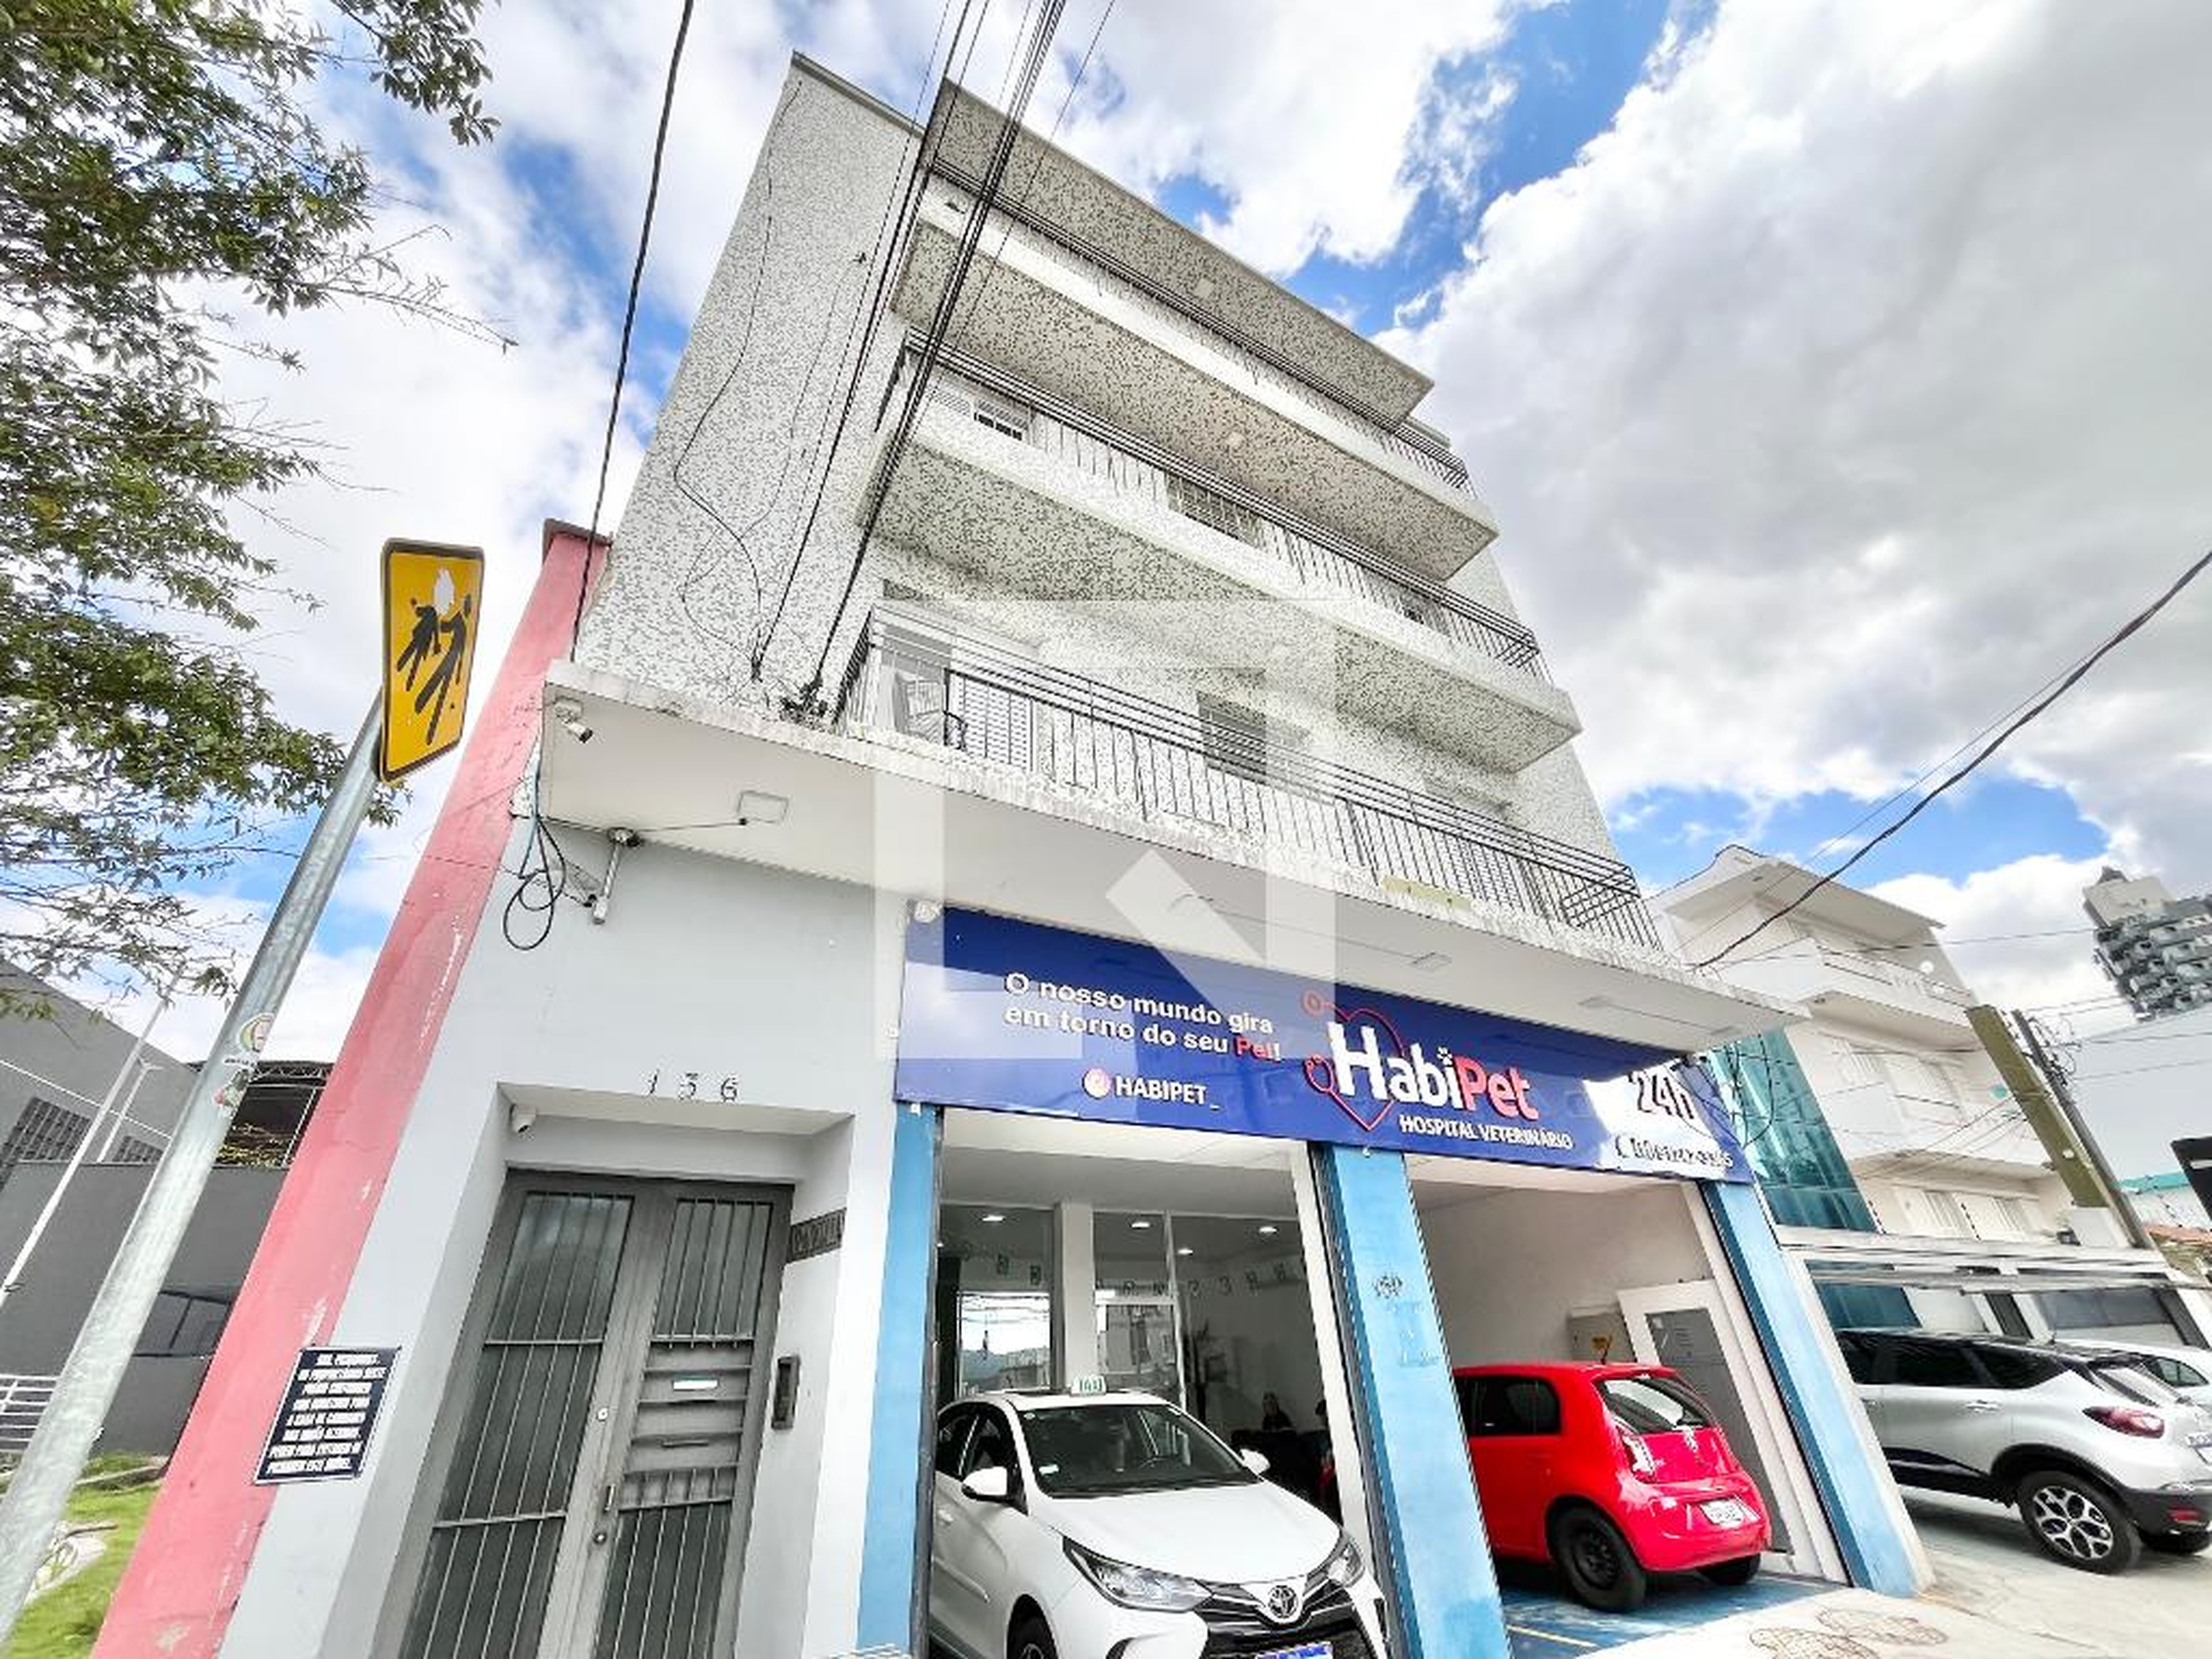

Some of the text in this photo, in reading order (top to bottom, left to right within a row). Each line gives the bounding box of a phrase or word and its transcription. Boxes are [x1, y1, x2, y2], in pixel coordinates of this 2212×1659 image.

[1005, 972, 1274, 1034] O nosso mundo gira
[1004, 1007, 1282, 1061] em torno do seu Pet!
[1327, 1021, 1539, 1120] HabiPet
[1399, 1113, 1479, 1139] HOSPITAL
